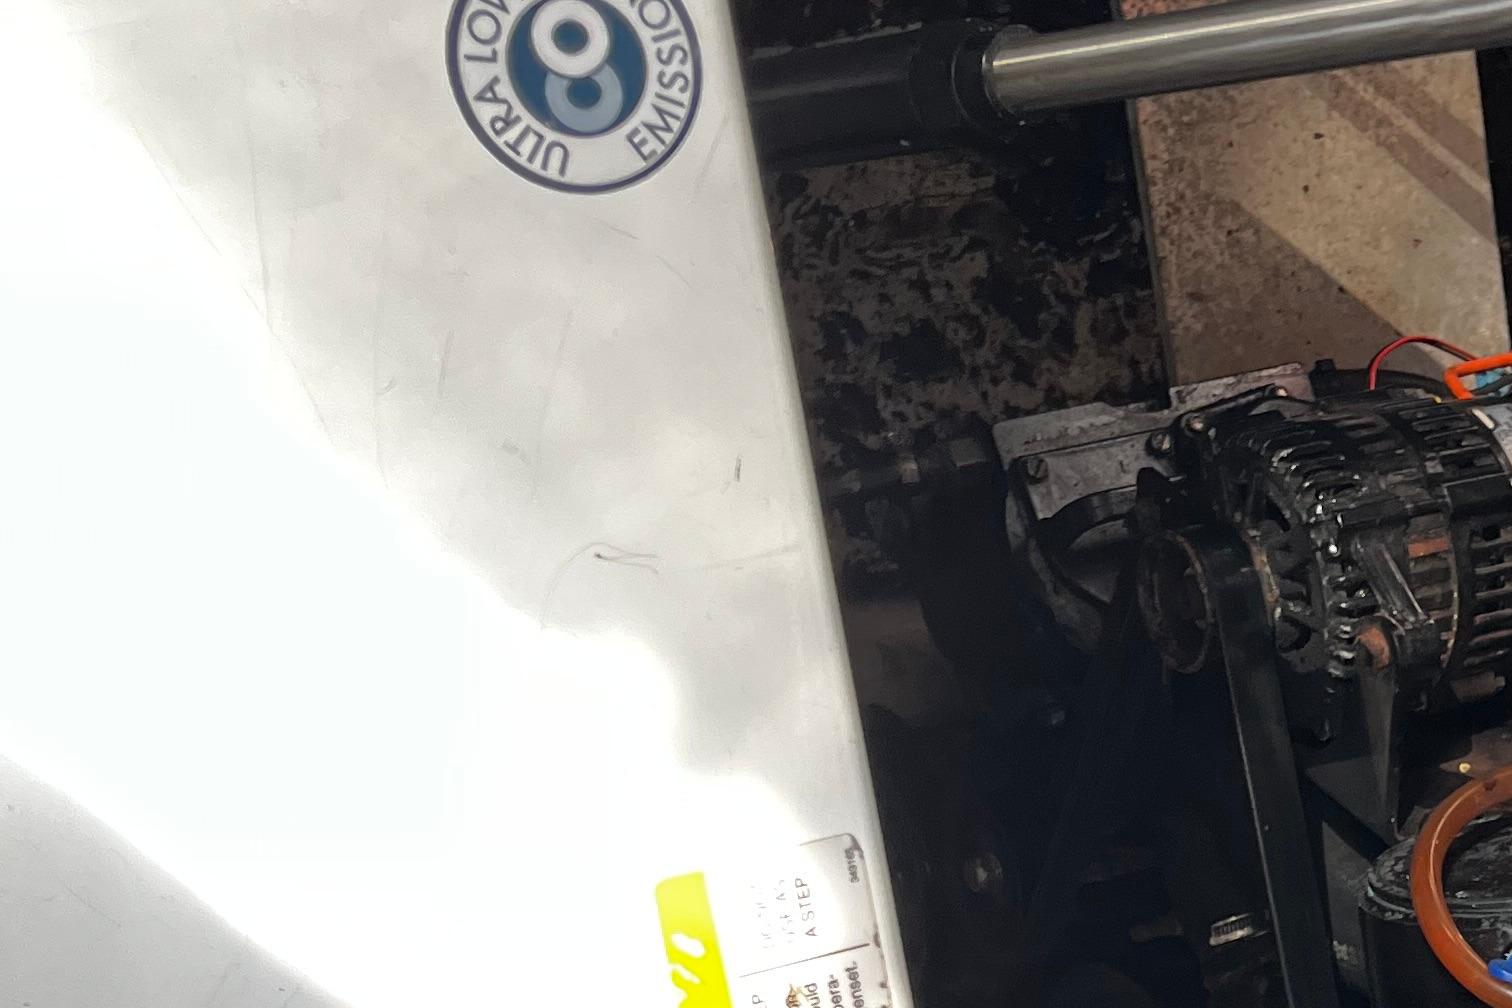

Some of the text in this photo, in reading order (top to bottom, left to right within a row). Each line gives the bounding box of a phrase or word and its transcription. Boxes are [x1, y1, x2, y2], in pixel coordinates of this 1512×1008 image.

[473, 76, 570, 177] ULTRA
[626, 0, 689, 164] EMISSIO
[795, 878, 815, 921] STEP
